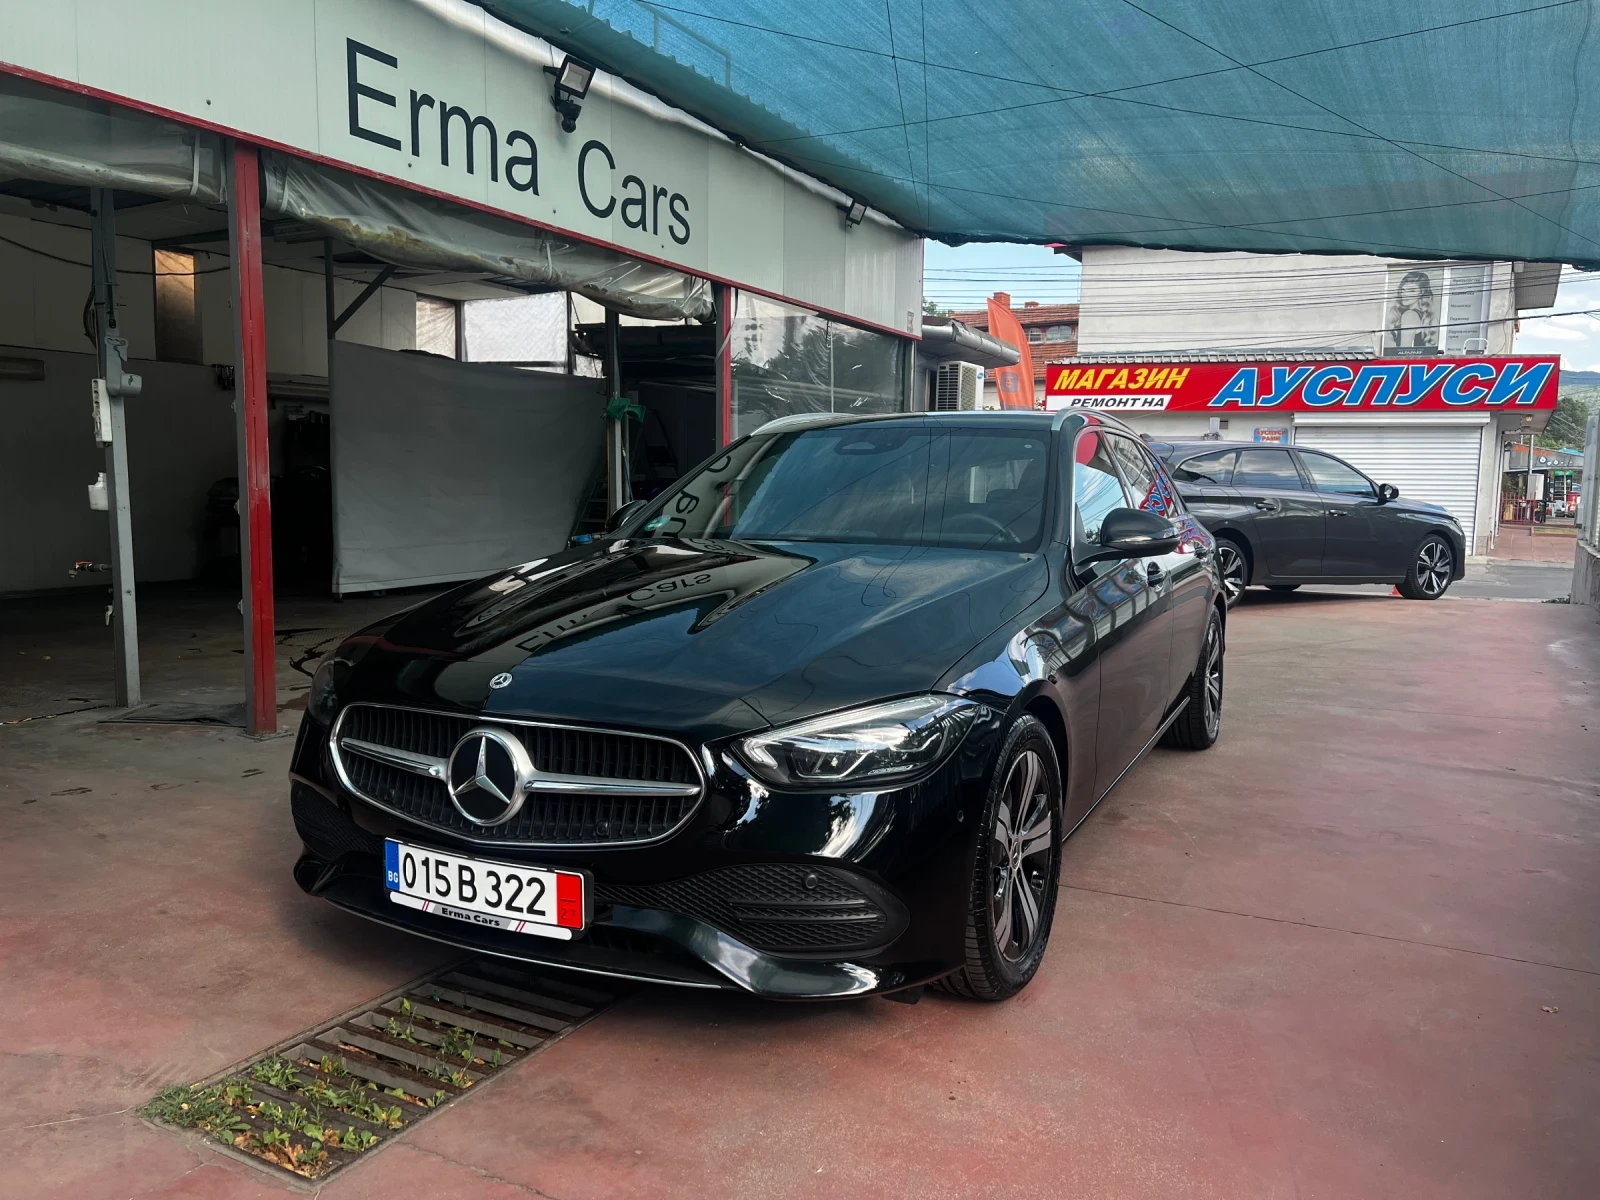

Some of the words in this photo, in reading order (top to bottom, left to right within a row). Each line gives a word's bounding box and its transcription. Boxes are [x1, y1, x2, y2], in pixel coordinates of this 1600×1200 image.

[346, 37, 540, 197] Erma
[577, 139, 691, 246] Cars
[1053, 368, 1190, 390] МАГАЗИН
[1207, 362, 1556, 408] АУСПУСИ
[1070, 398, 1141, 408] РЕМОНТ
[1141, 397, 1164, 407] НА
[387, 869, 399, 884] BG
[402, 852, 451, 898] 015
[458, 863, 478, 904] B
[484, 869, 546, 917] 322
[441, 907, 471, 921] Erma
[473, 914, 501, 928] Cars
[560, 907, 576, 921] 27
